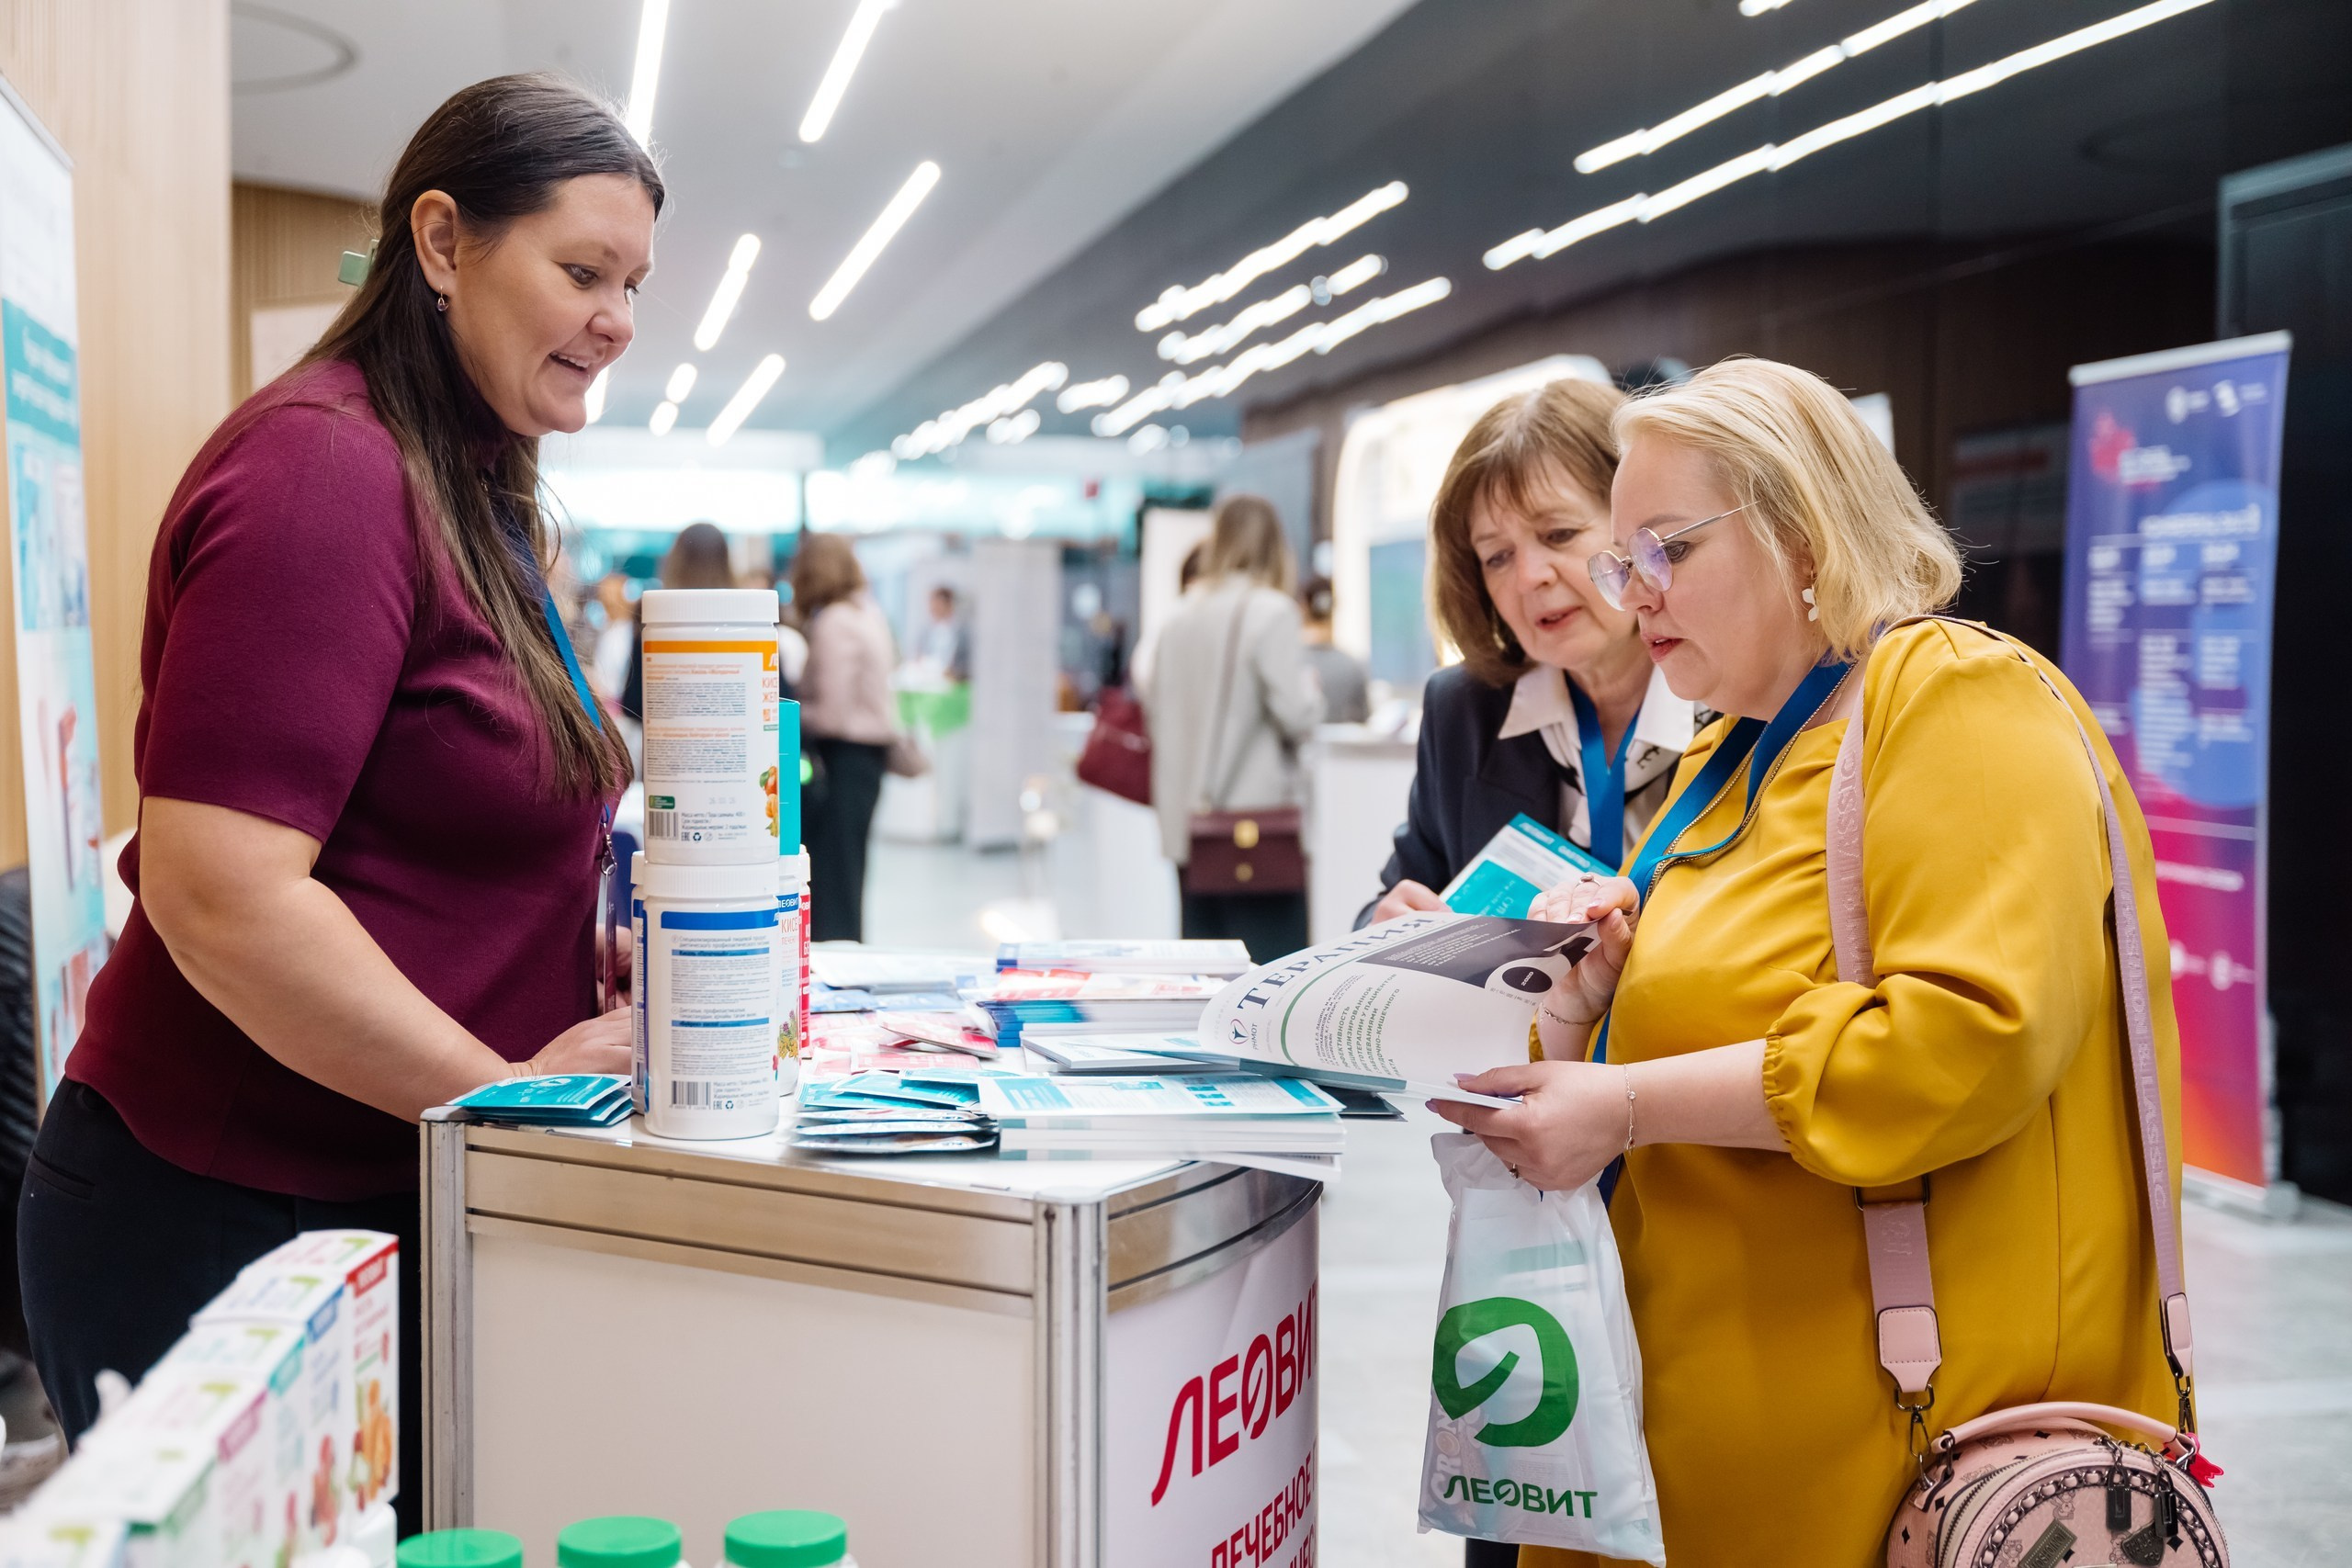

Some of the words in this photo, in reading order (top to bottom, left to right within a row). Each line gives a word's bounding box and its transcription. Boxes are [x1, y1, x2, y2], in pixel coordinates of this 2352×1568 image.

[1237, 919, 1433, 1010] ТЕРАПИЯ
[1364, 974, 1396, 1011] ПАЦИЕНТОВ
[1443, 1474, 1598, 1518] ЛЕОВИТ
